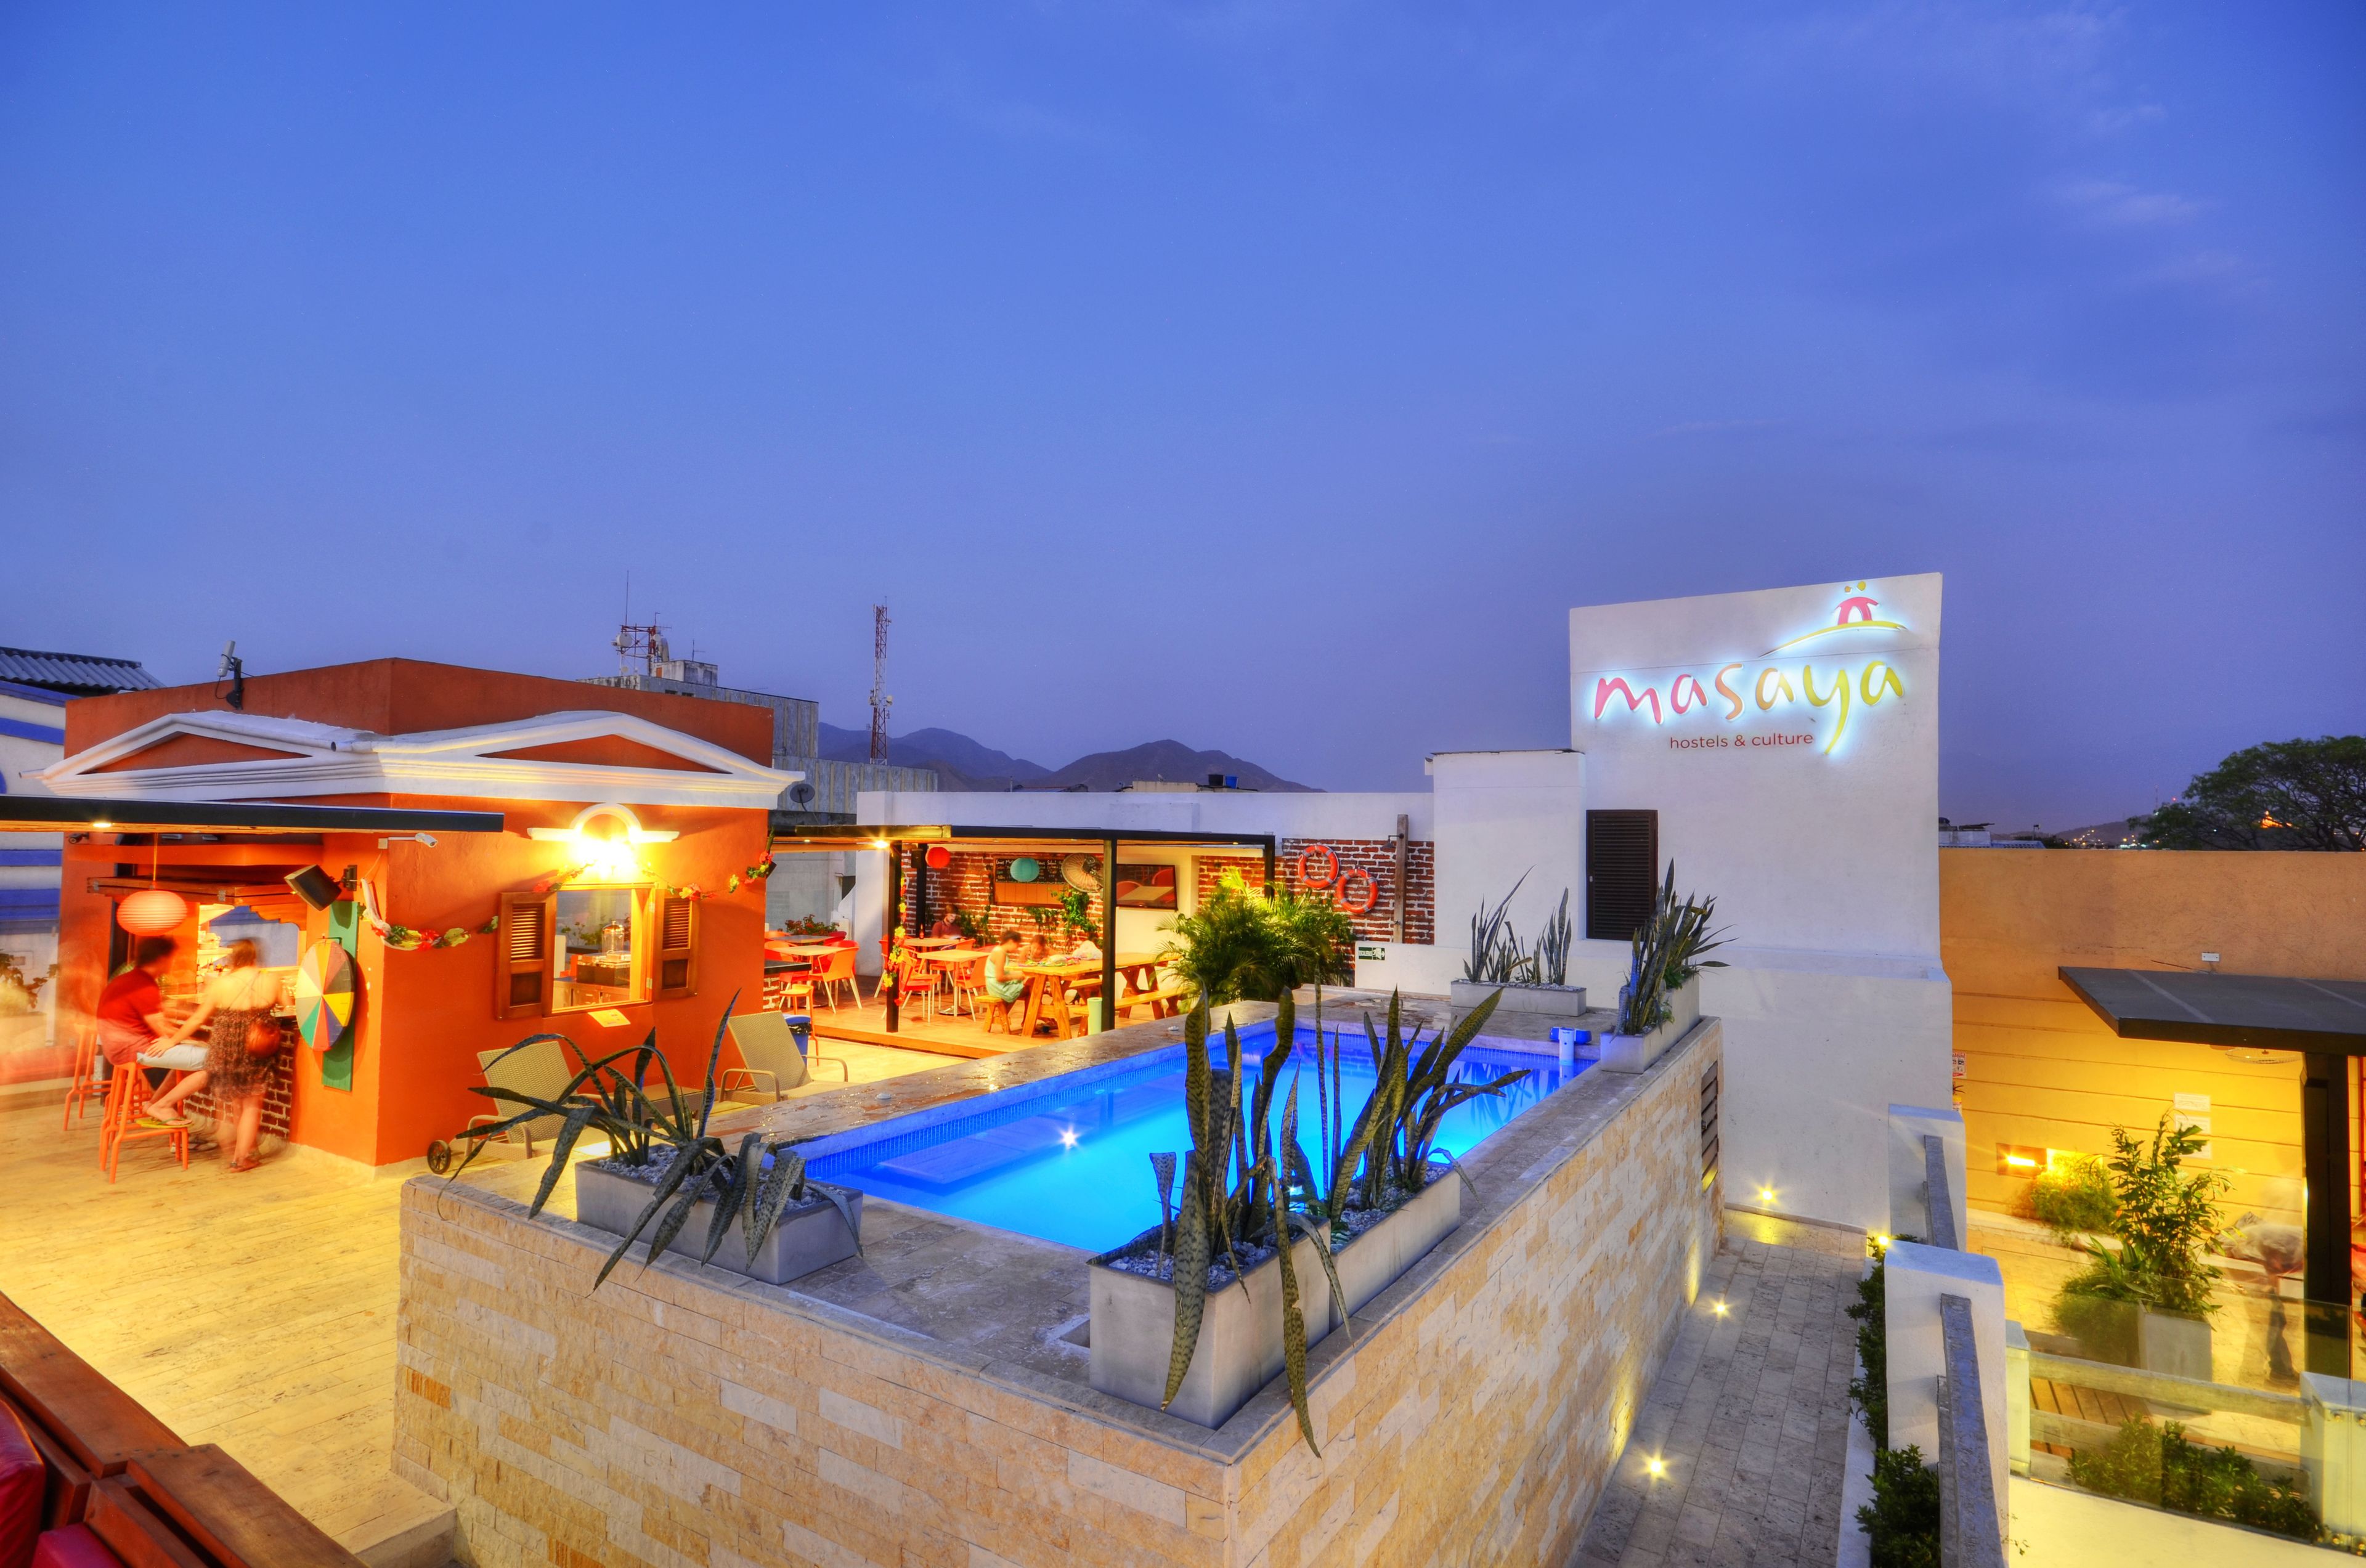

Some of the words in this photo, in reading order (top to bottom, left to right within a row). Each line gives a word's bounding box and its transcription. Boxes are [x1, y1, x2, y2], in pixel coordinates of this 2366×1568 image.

[1594, 660, 1904, 755] masaya
[1670, 735, 1728, 749] hostels
[1734, 734, 1746, 747] &
[1752, 733, 1814, 747] culture
